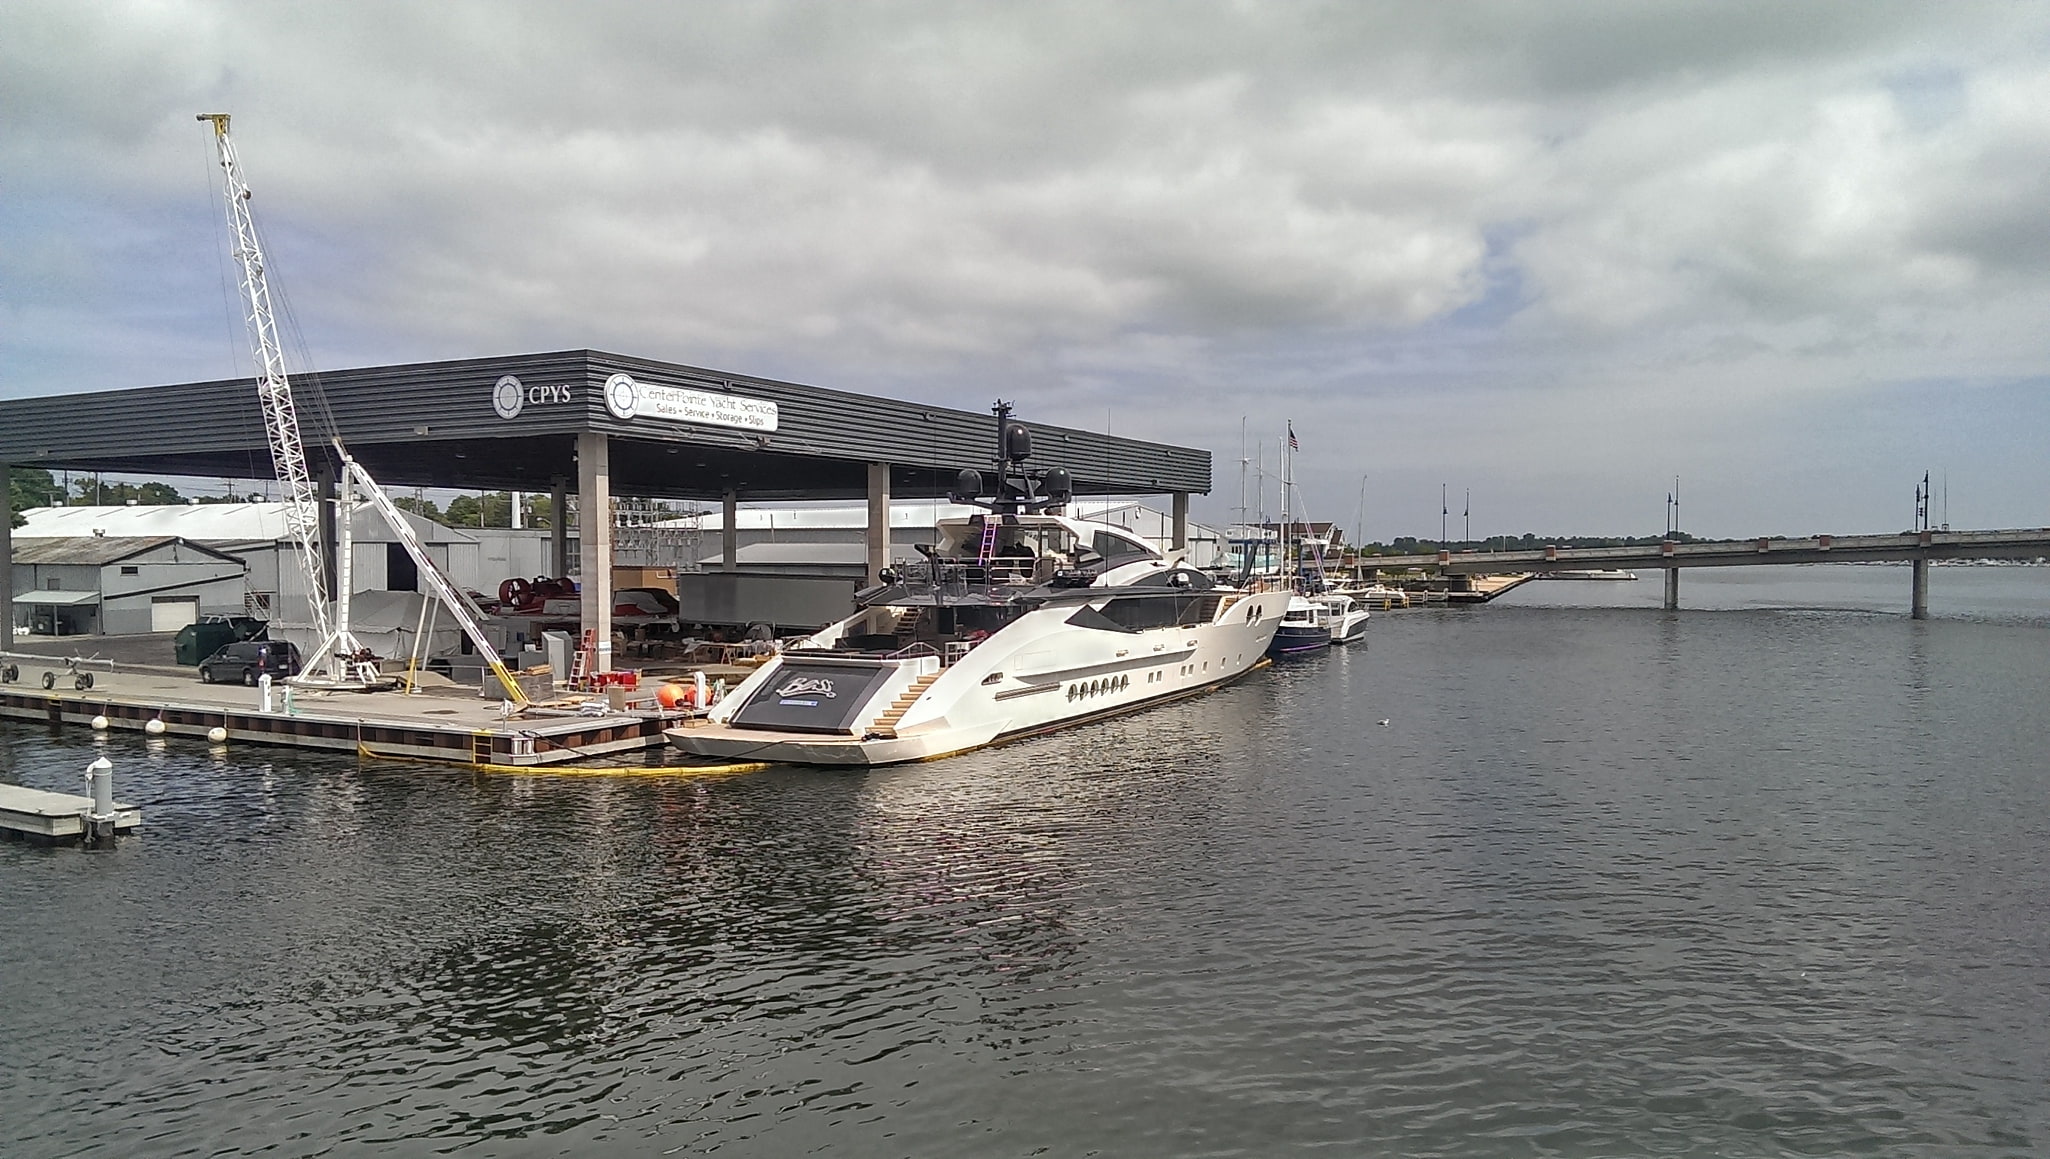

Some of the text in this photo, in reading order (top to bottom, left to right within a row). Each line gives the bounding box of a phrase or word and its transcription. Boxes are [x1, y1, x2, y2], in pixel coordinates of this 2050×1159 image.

[529, 385, 570, 403] CPYS
[656, 403, 764, 426] Sales Service Storage Slips
[709, 396, 736, 409] Yacht
[740, 399, 777, 415] Services
